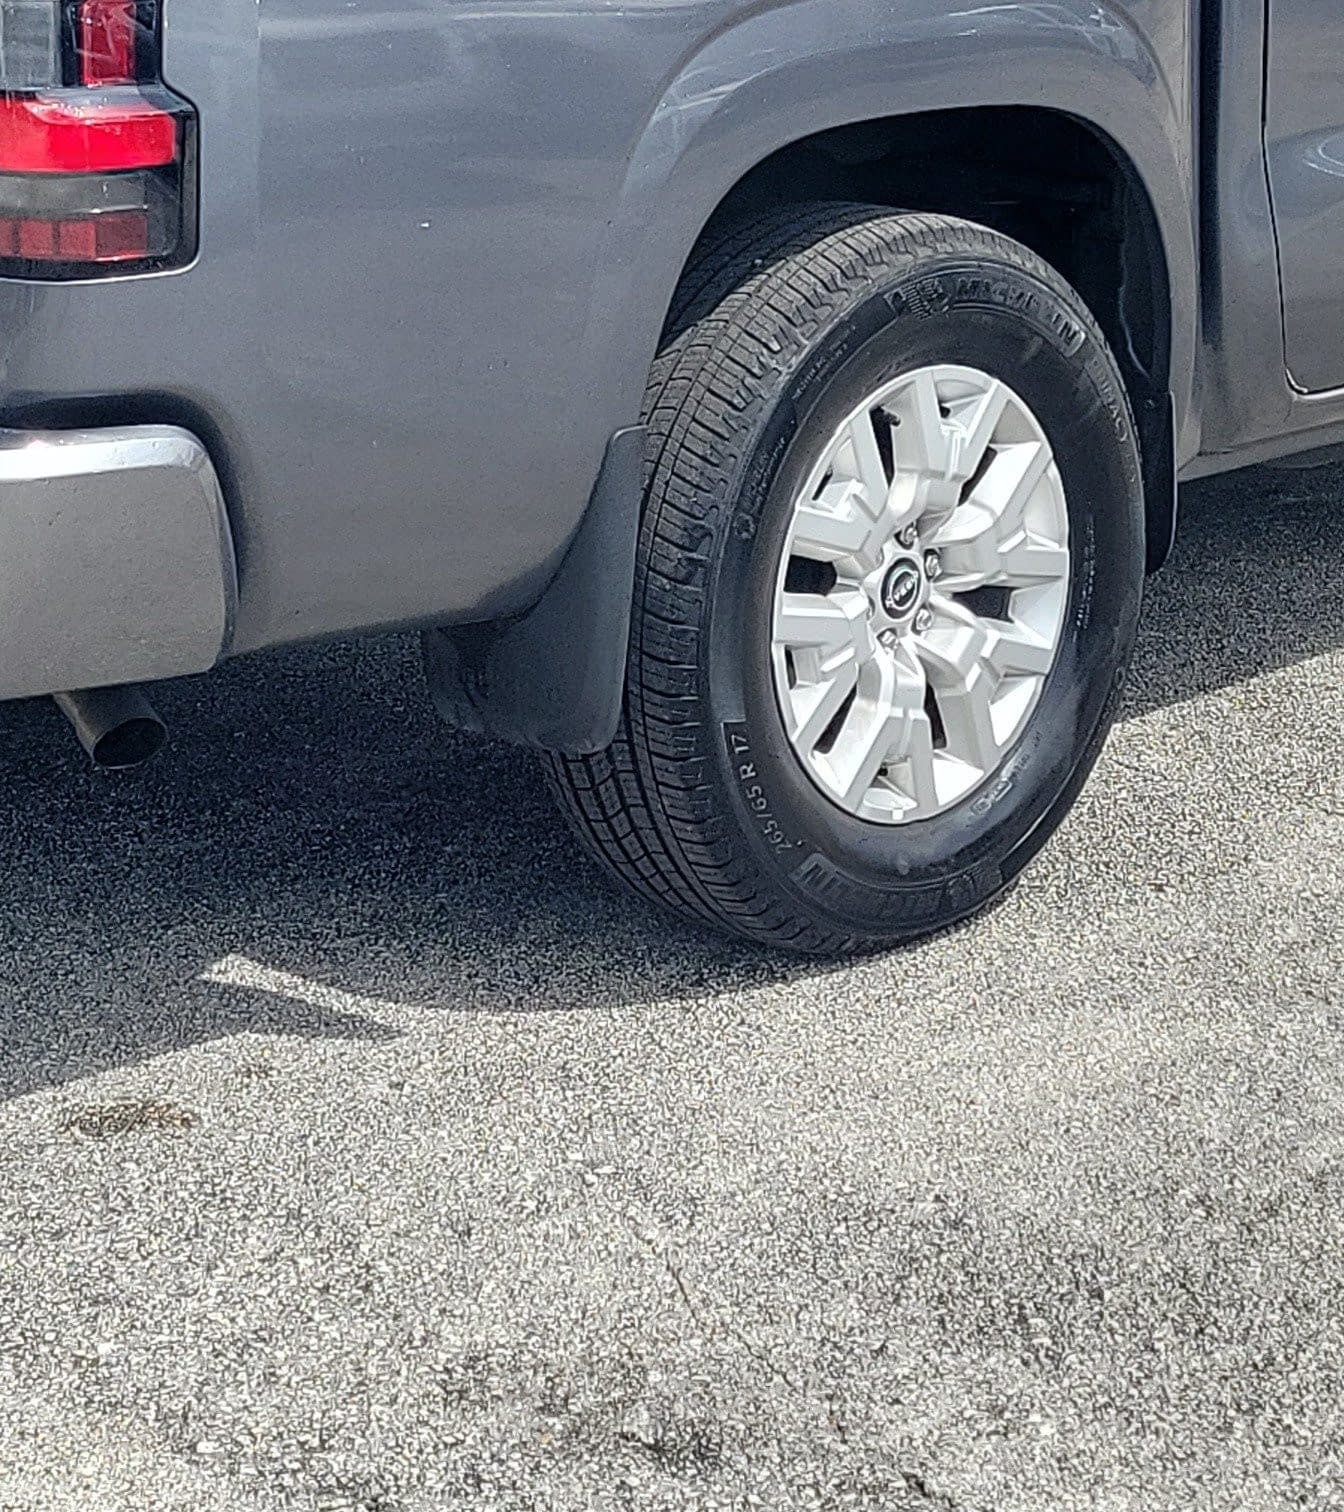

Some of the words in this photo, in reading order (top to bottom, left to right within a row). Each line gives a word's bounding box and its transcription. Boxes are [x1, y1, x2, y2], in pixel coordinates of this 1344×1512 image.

[731, 734, 750, 755] 17
[739, 762, 756, 780] R
[745, 785, 793, 855] 265/65
